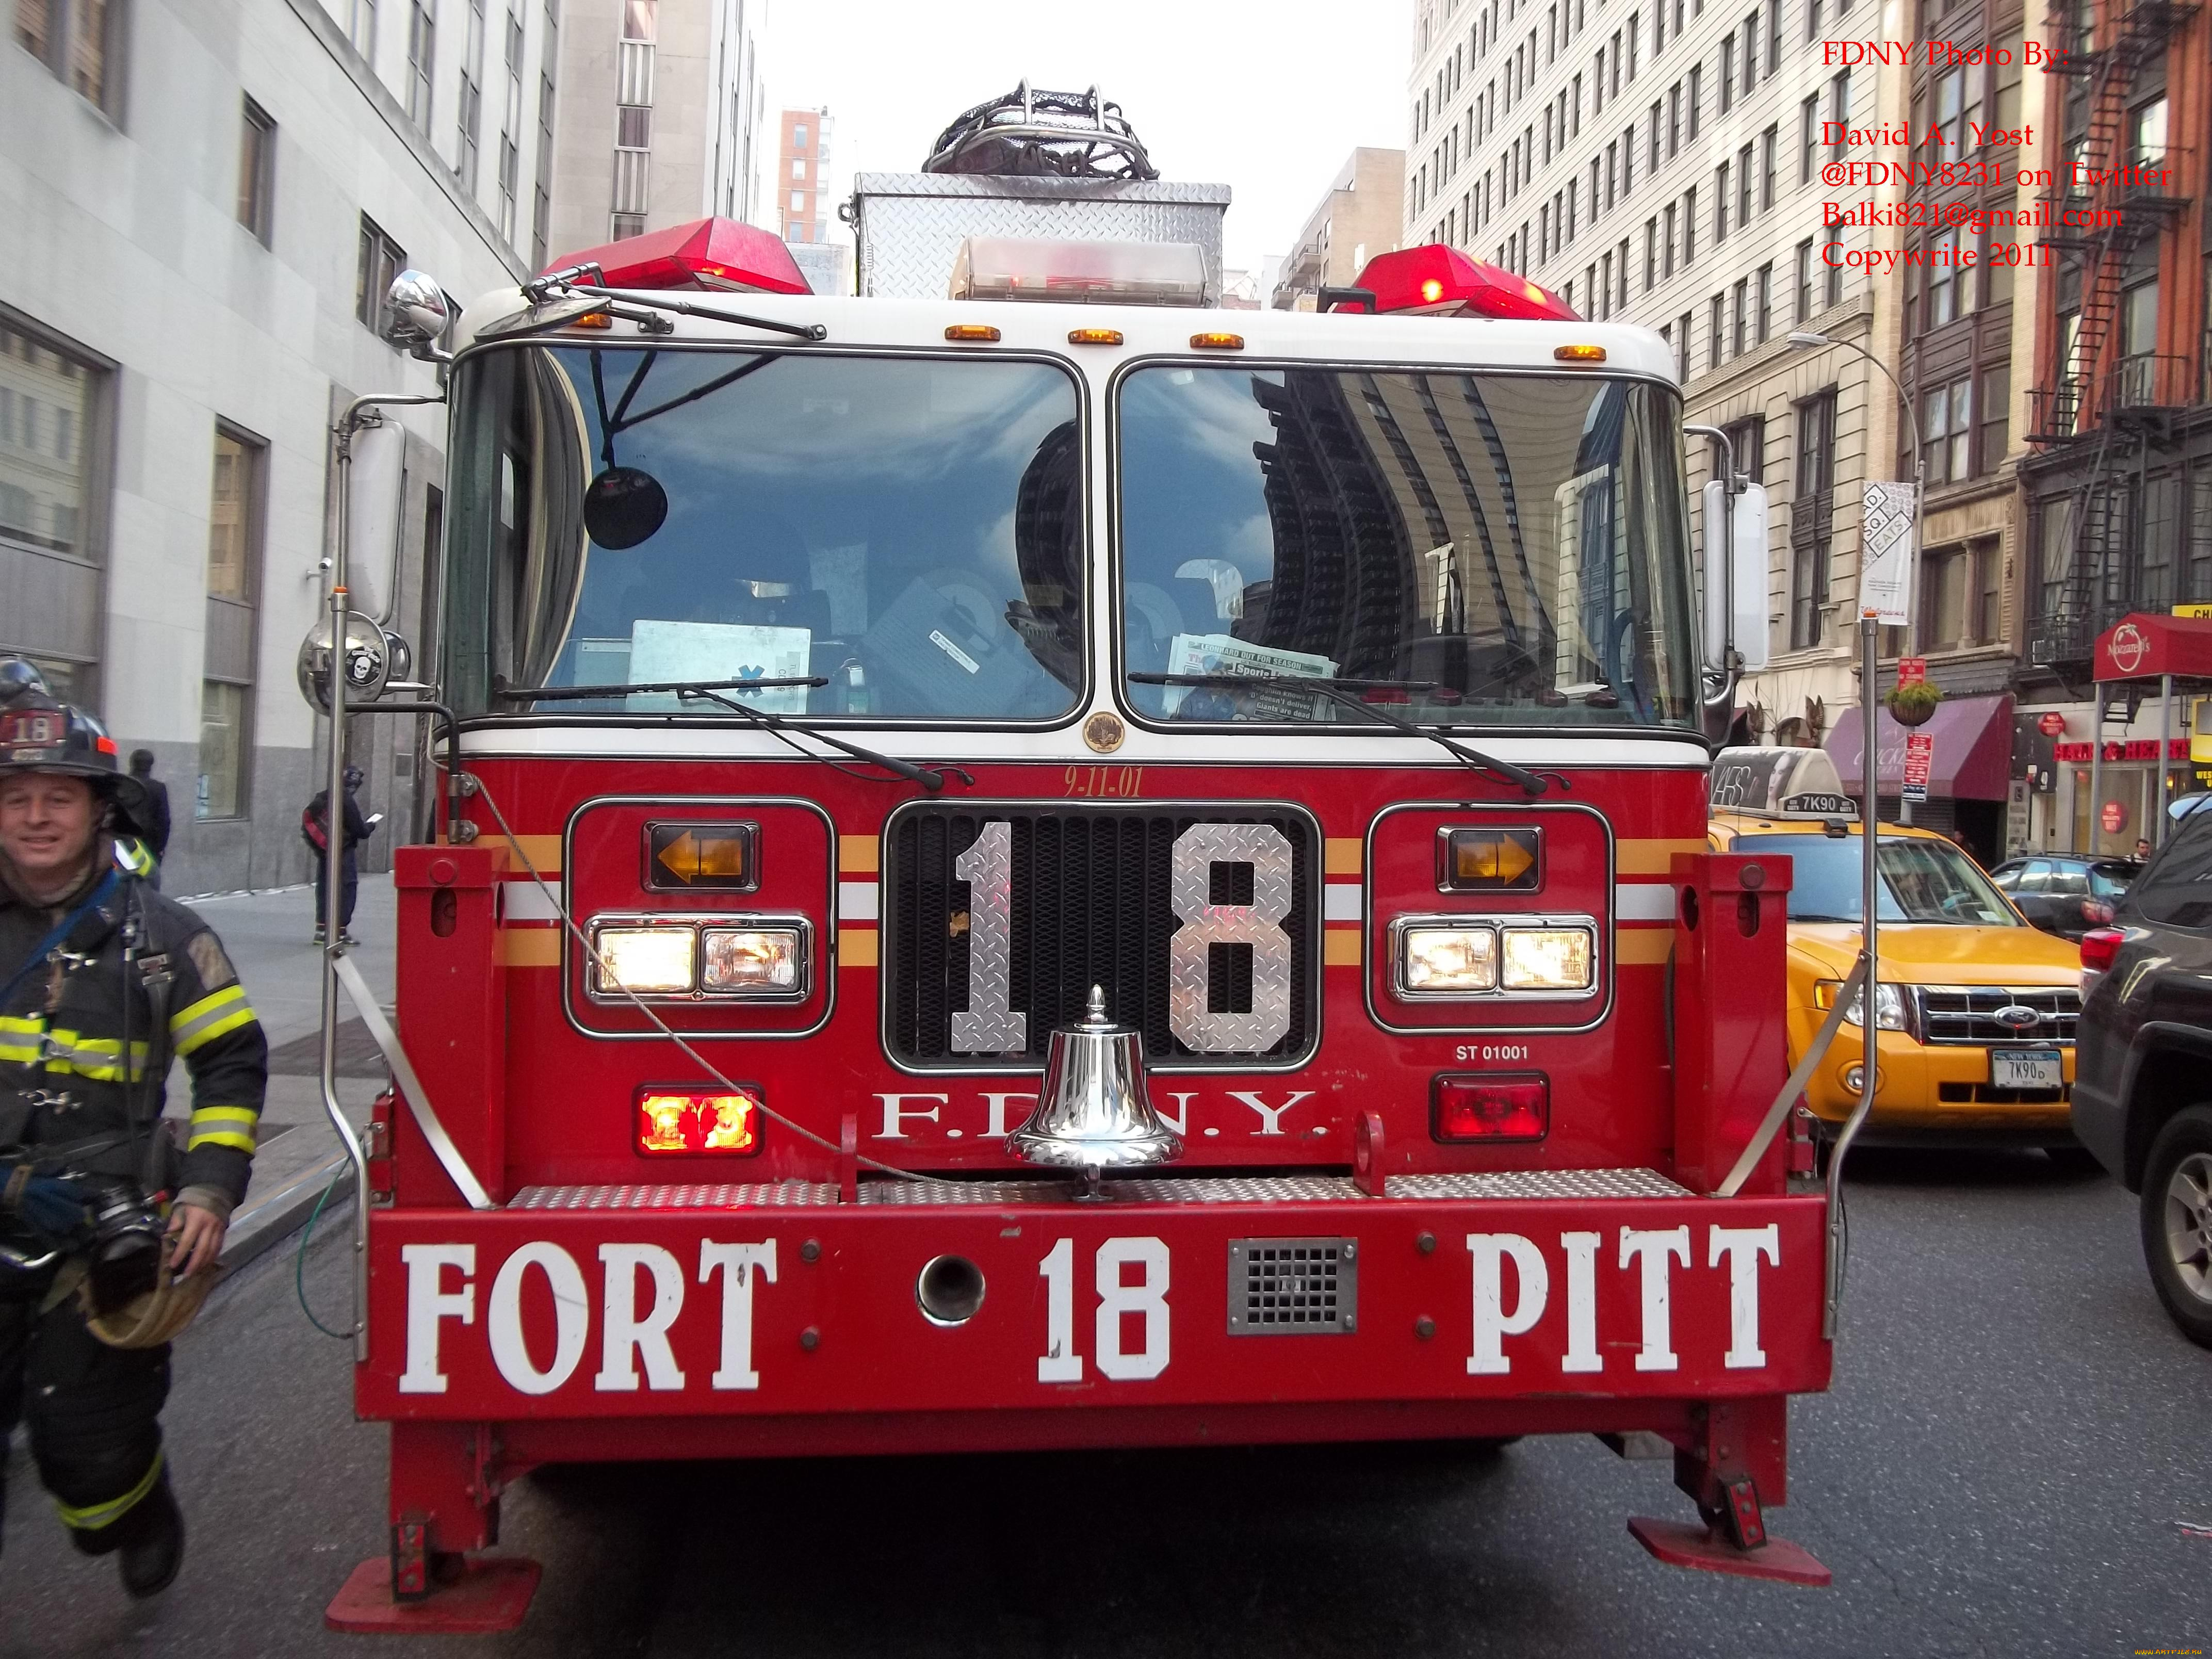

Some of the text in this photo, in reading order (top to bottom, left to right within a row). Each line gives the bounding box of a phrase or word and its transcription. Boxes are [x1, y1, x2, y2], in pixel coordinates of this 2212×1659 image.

[1862, 517, 1884, 537] SQ.
[1873, 519, 1907, 551] EATS.
[2194, 609, 2212, 619] CH
[1201, 643, 1239, 657] LEONHARD
[1241, 652, 1256, 661] OUT
[1257, 654, 1272, 664] FOR
[1273, 658, 1302, 670] SEASON
[1237, 663, 1270, 677] Sports
[1251, 683, 1281, 695] Coughlin
[1283, 690, 1306, 701] knows
[1257, 702, 1278, 712] Giants
[1293, 710, 1311, 719] dead
[1260, 694, 1285, 705] doesn't
[1287, 700, 1312, 711] deliver,
[12, 717, 50, 742] 18
[1064, 765, 1143, 798] 9-11-01
[1802, 796, 1835, 810] 7K90
[1456, 1045, 1528, 1060] ST 01001
[398, 1223, 1780, 1395] FORT 18 PITT
